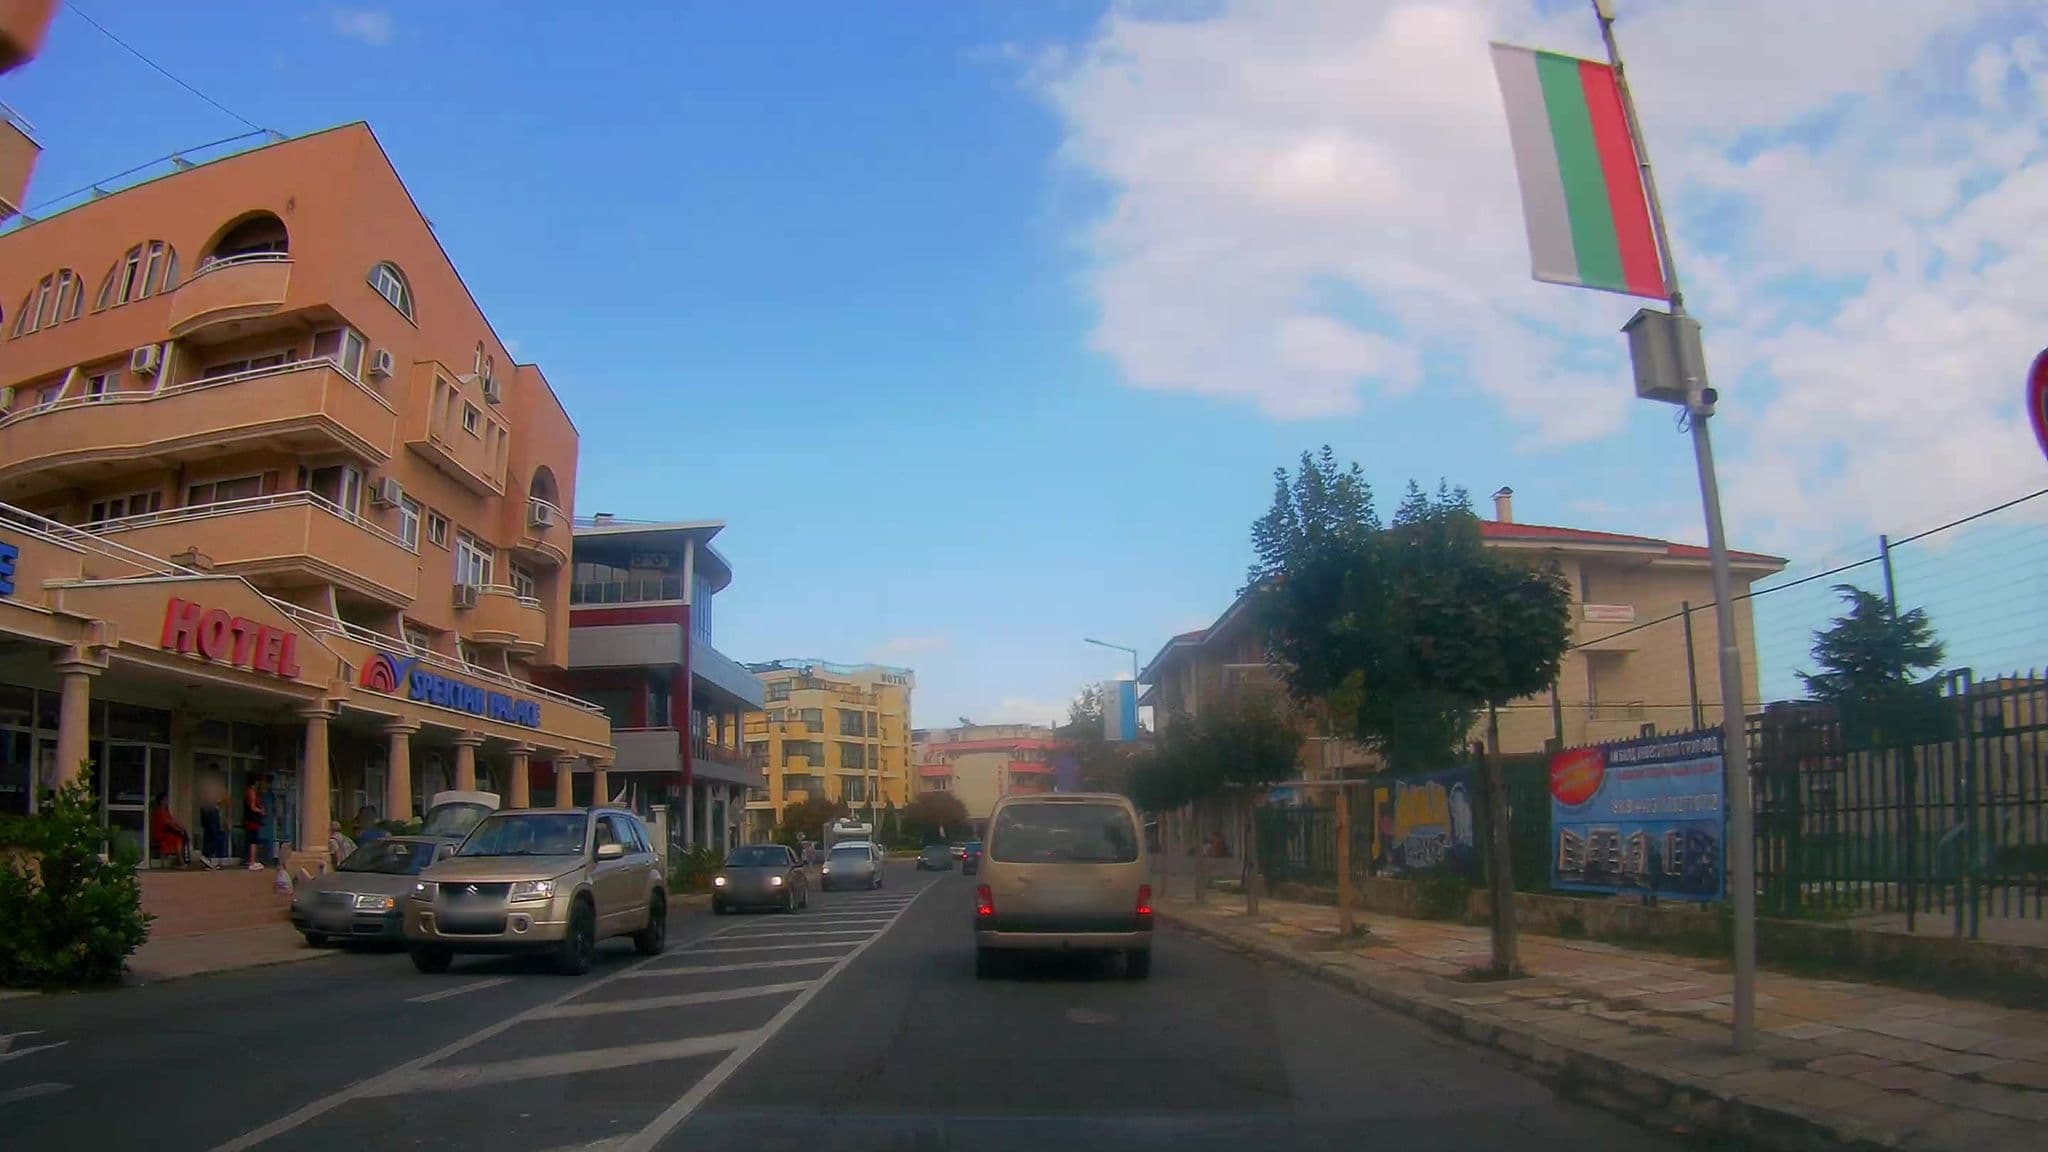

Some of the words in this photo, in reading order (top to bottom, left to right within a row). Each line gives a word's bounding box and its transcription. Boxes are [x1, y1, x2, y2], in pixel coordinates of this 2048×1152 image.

[162, 596, 300, 678] HOTEL
[409, 669, 486, 715] SPEKTAR
[487, 691, 541, 728] PALACE
[881, 673, 908, 685] HOTEL
